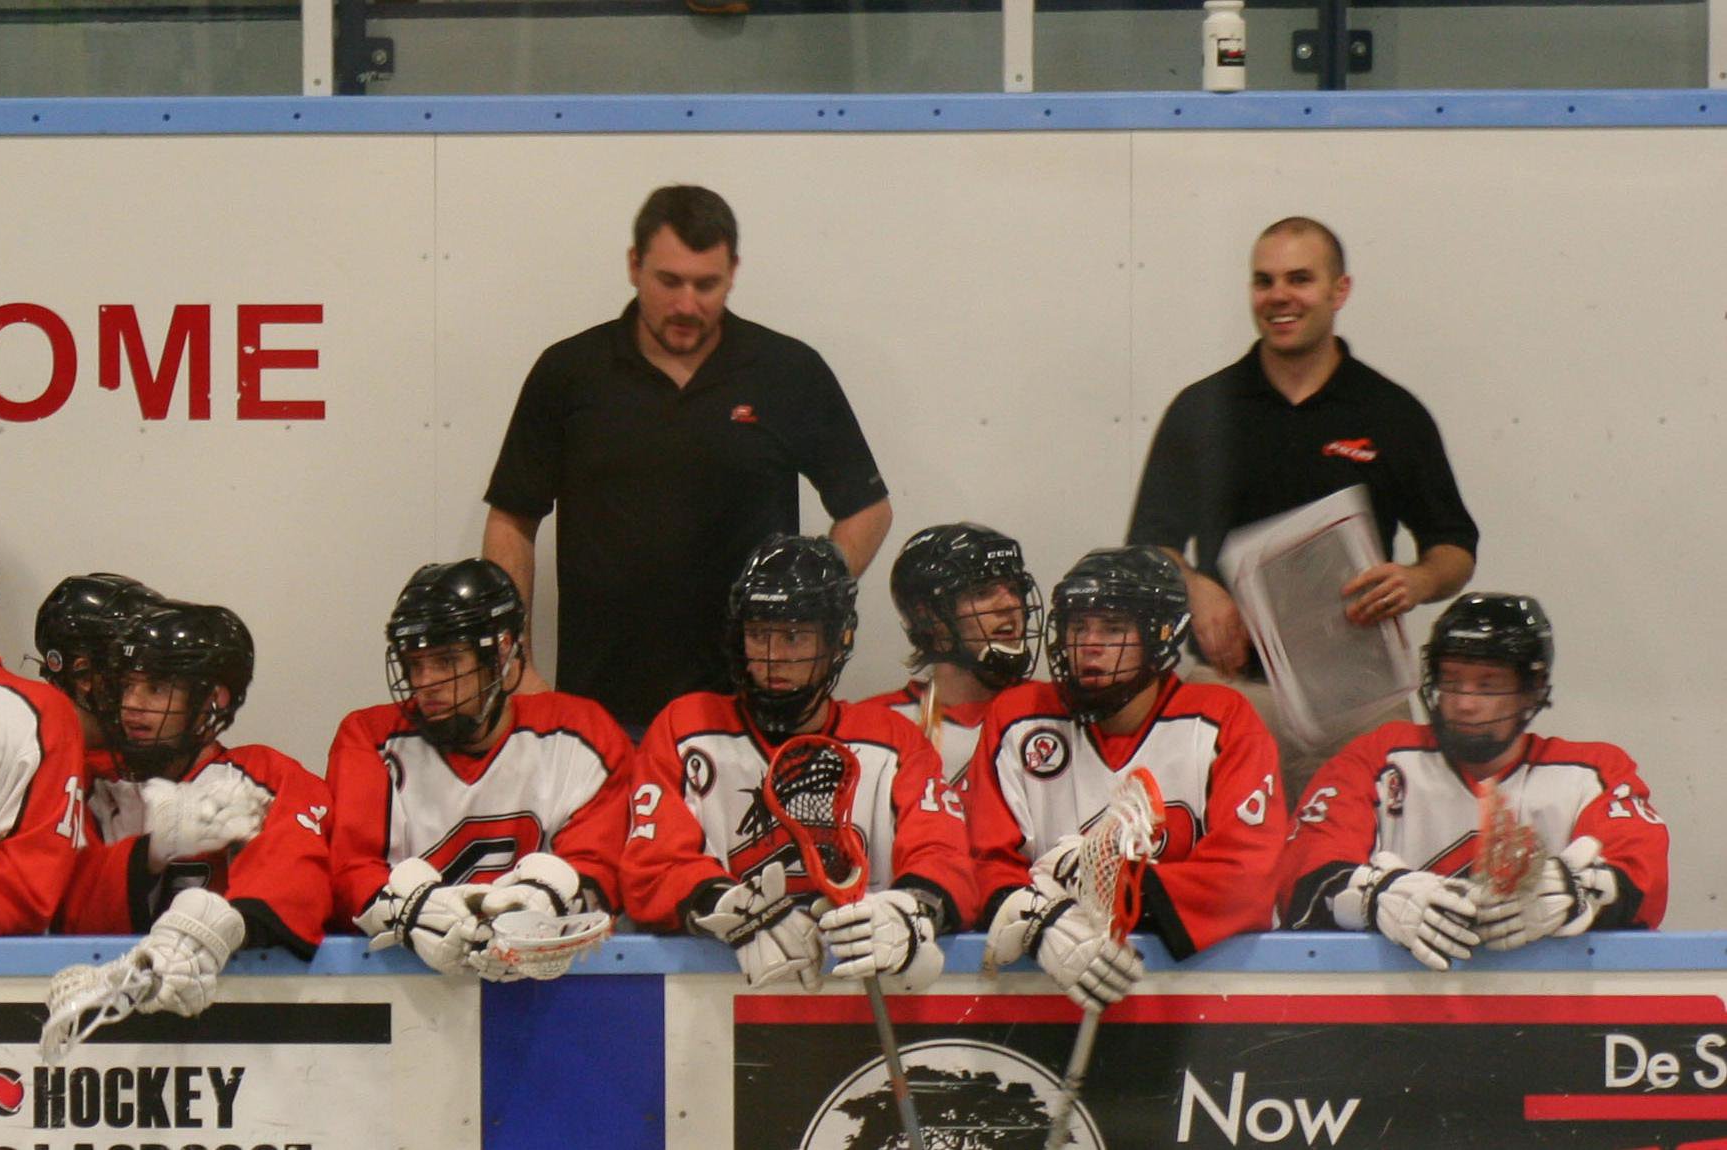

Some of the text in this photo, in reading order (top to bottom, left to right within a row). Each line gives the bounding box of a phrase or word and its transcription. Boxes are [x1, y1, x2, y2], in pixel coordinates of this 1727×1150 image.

[1605, 1033, 1681, 1090] De
[33, 1066, 246, 1130] HOCKEY
[1176, 1070, 1361, 1145] Now
